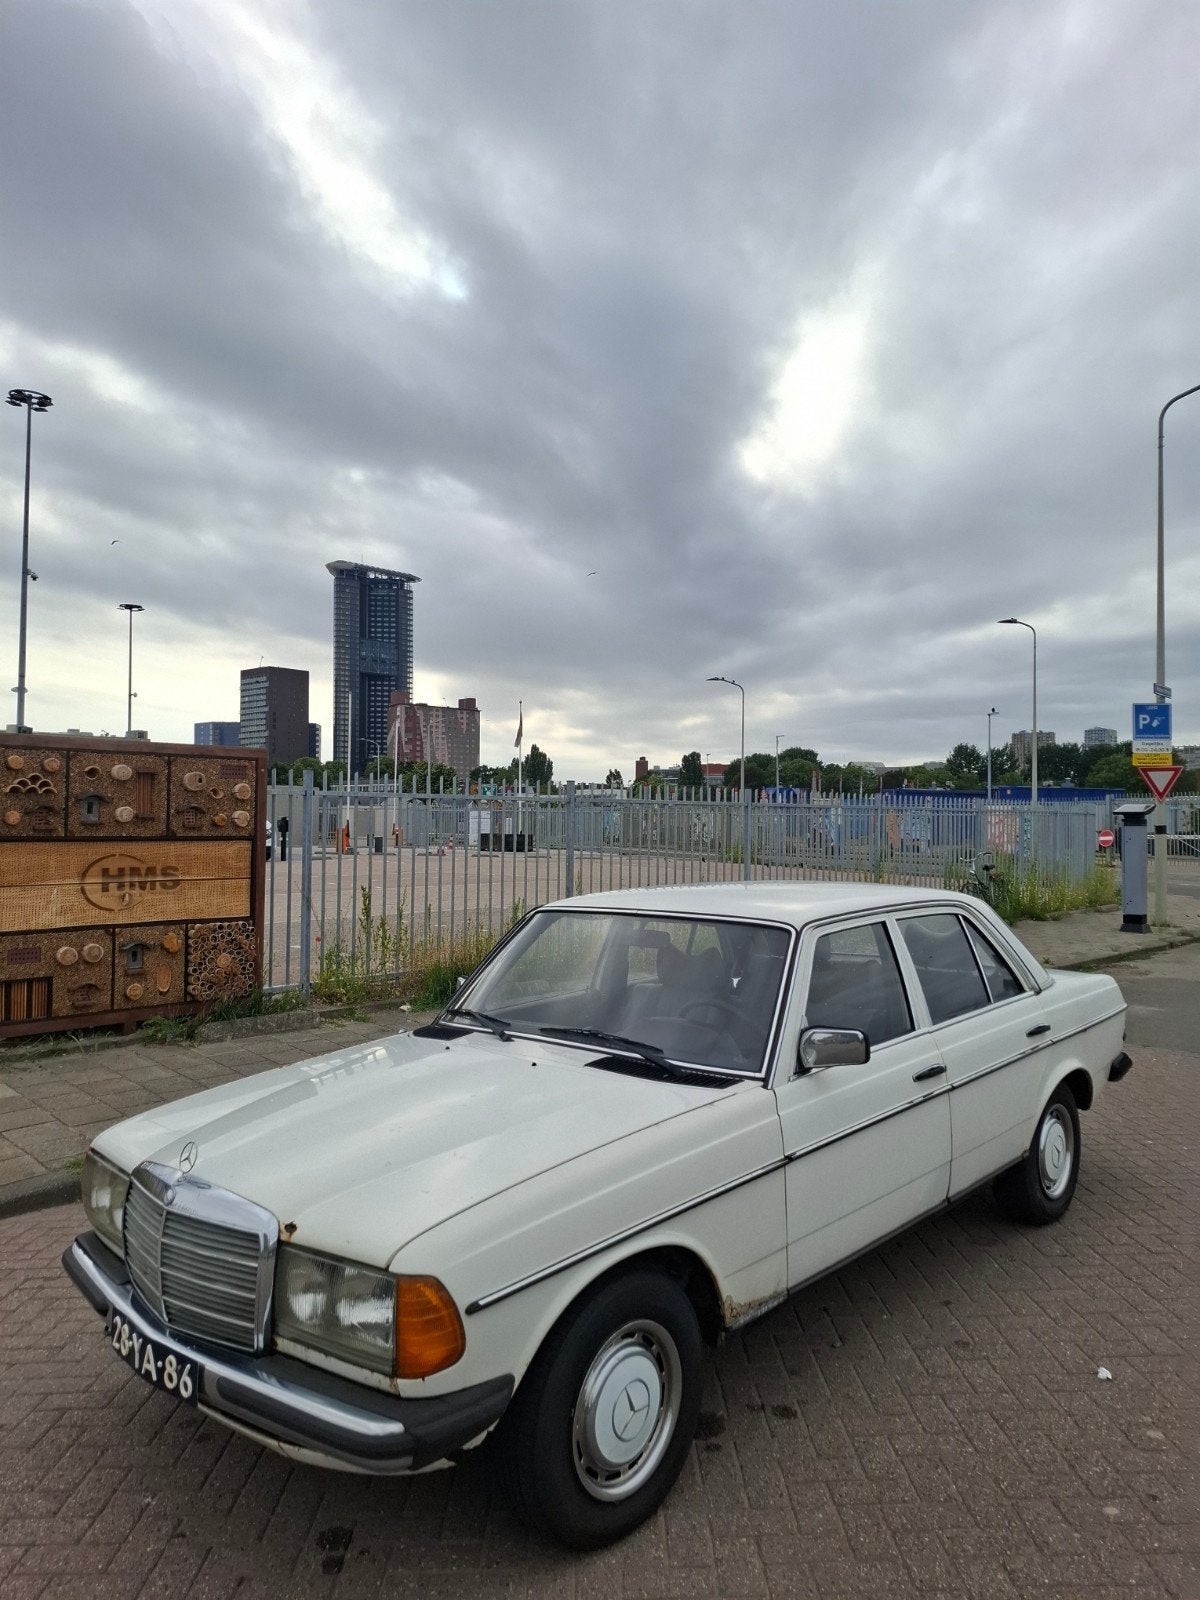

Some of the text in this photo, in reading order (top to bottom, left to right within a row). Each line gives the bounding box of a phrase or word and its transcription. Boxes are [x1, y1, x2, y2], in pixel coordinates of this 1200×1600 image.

[1139, 714, 1150, 730] P
[101, 865, 181, 893] HMS
[112, 1315, 193, 1399] 28-YA-86
